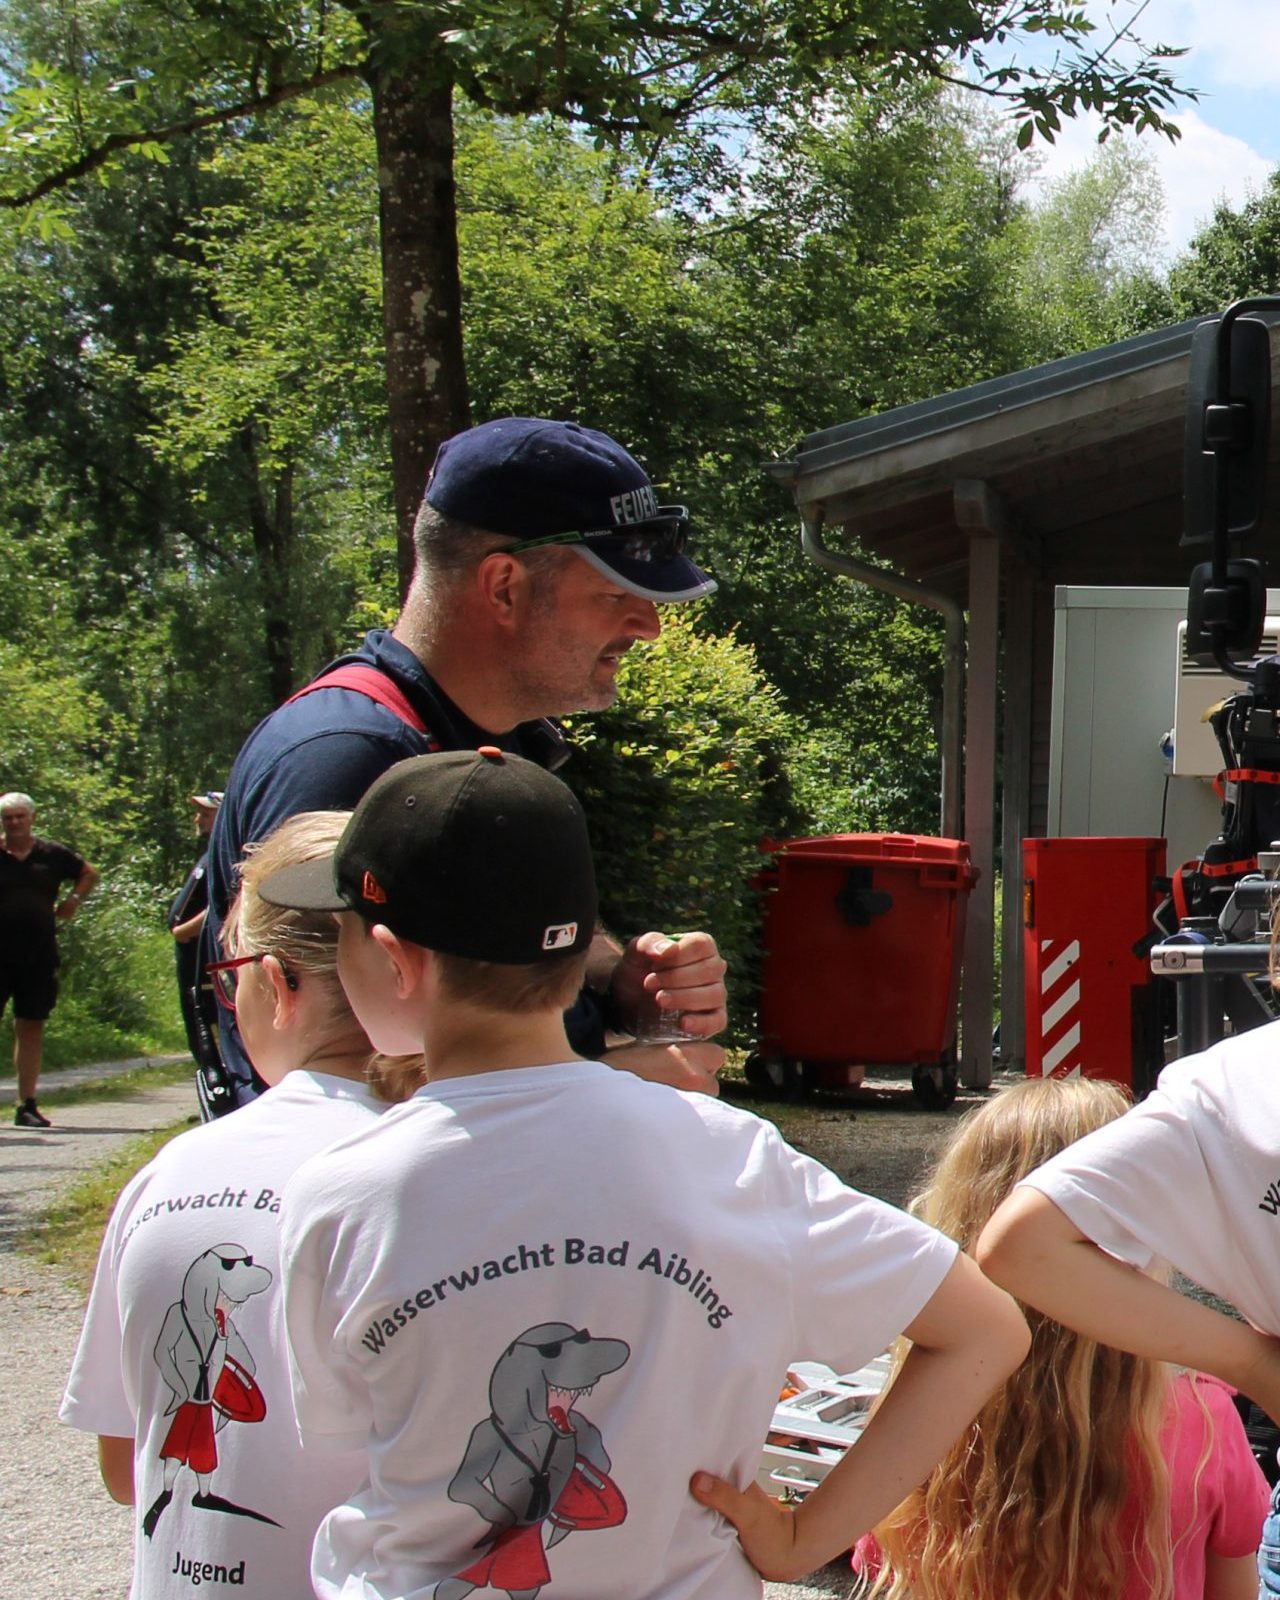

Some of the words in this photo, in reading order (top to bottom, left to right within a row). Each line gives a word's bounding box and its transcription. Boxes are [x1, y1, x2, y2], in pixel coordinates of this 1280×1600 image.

[253, 1188, 282, 1214] Ba
[361, 1243, 555, 1355] Wasserwacht
[563, 1237, 631, 1267] Bad
[637, 1246, 734, 1330] Aibling
[171, 1551, 246, 1586] Jugend
